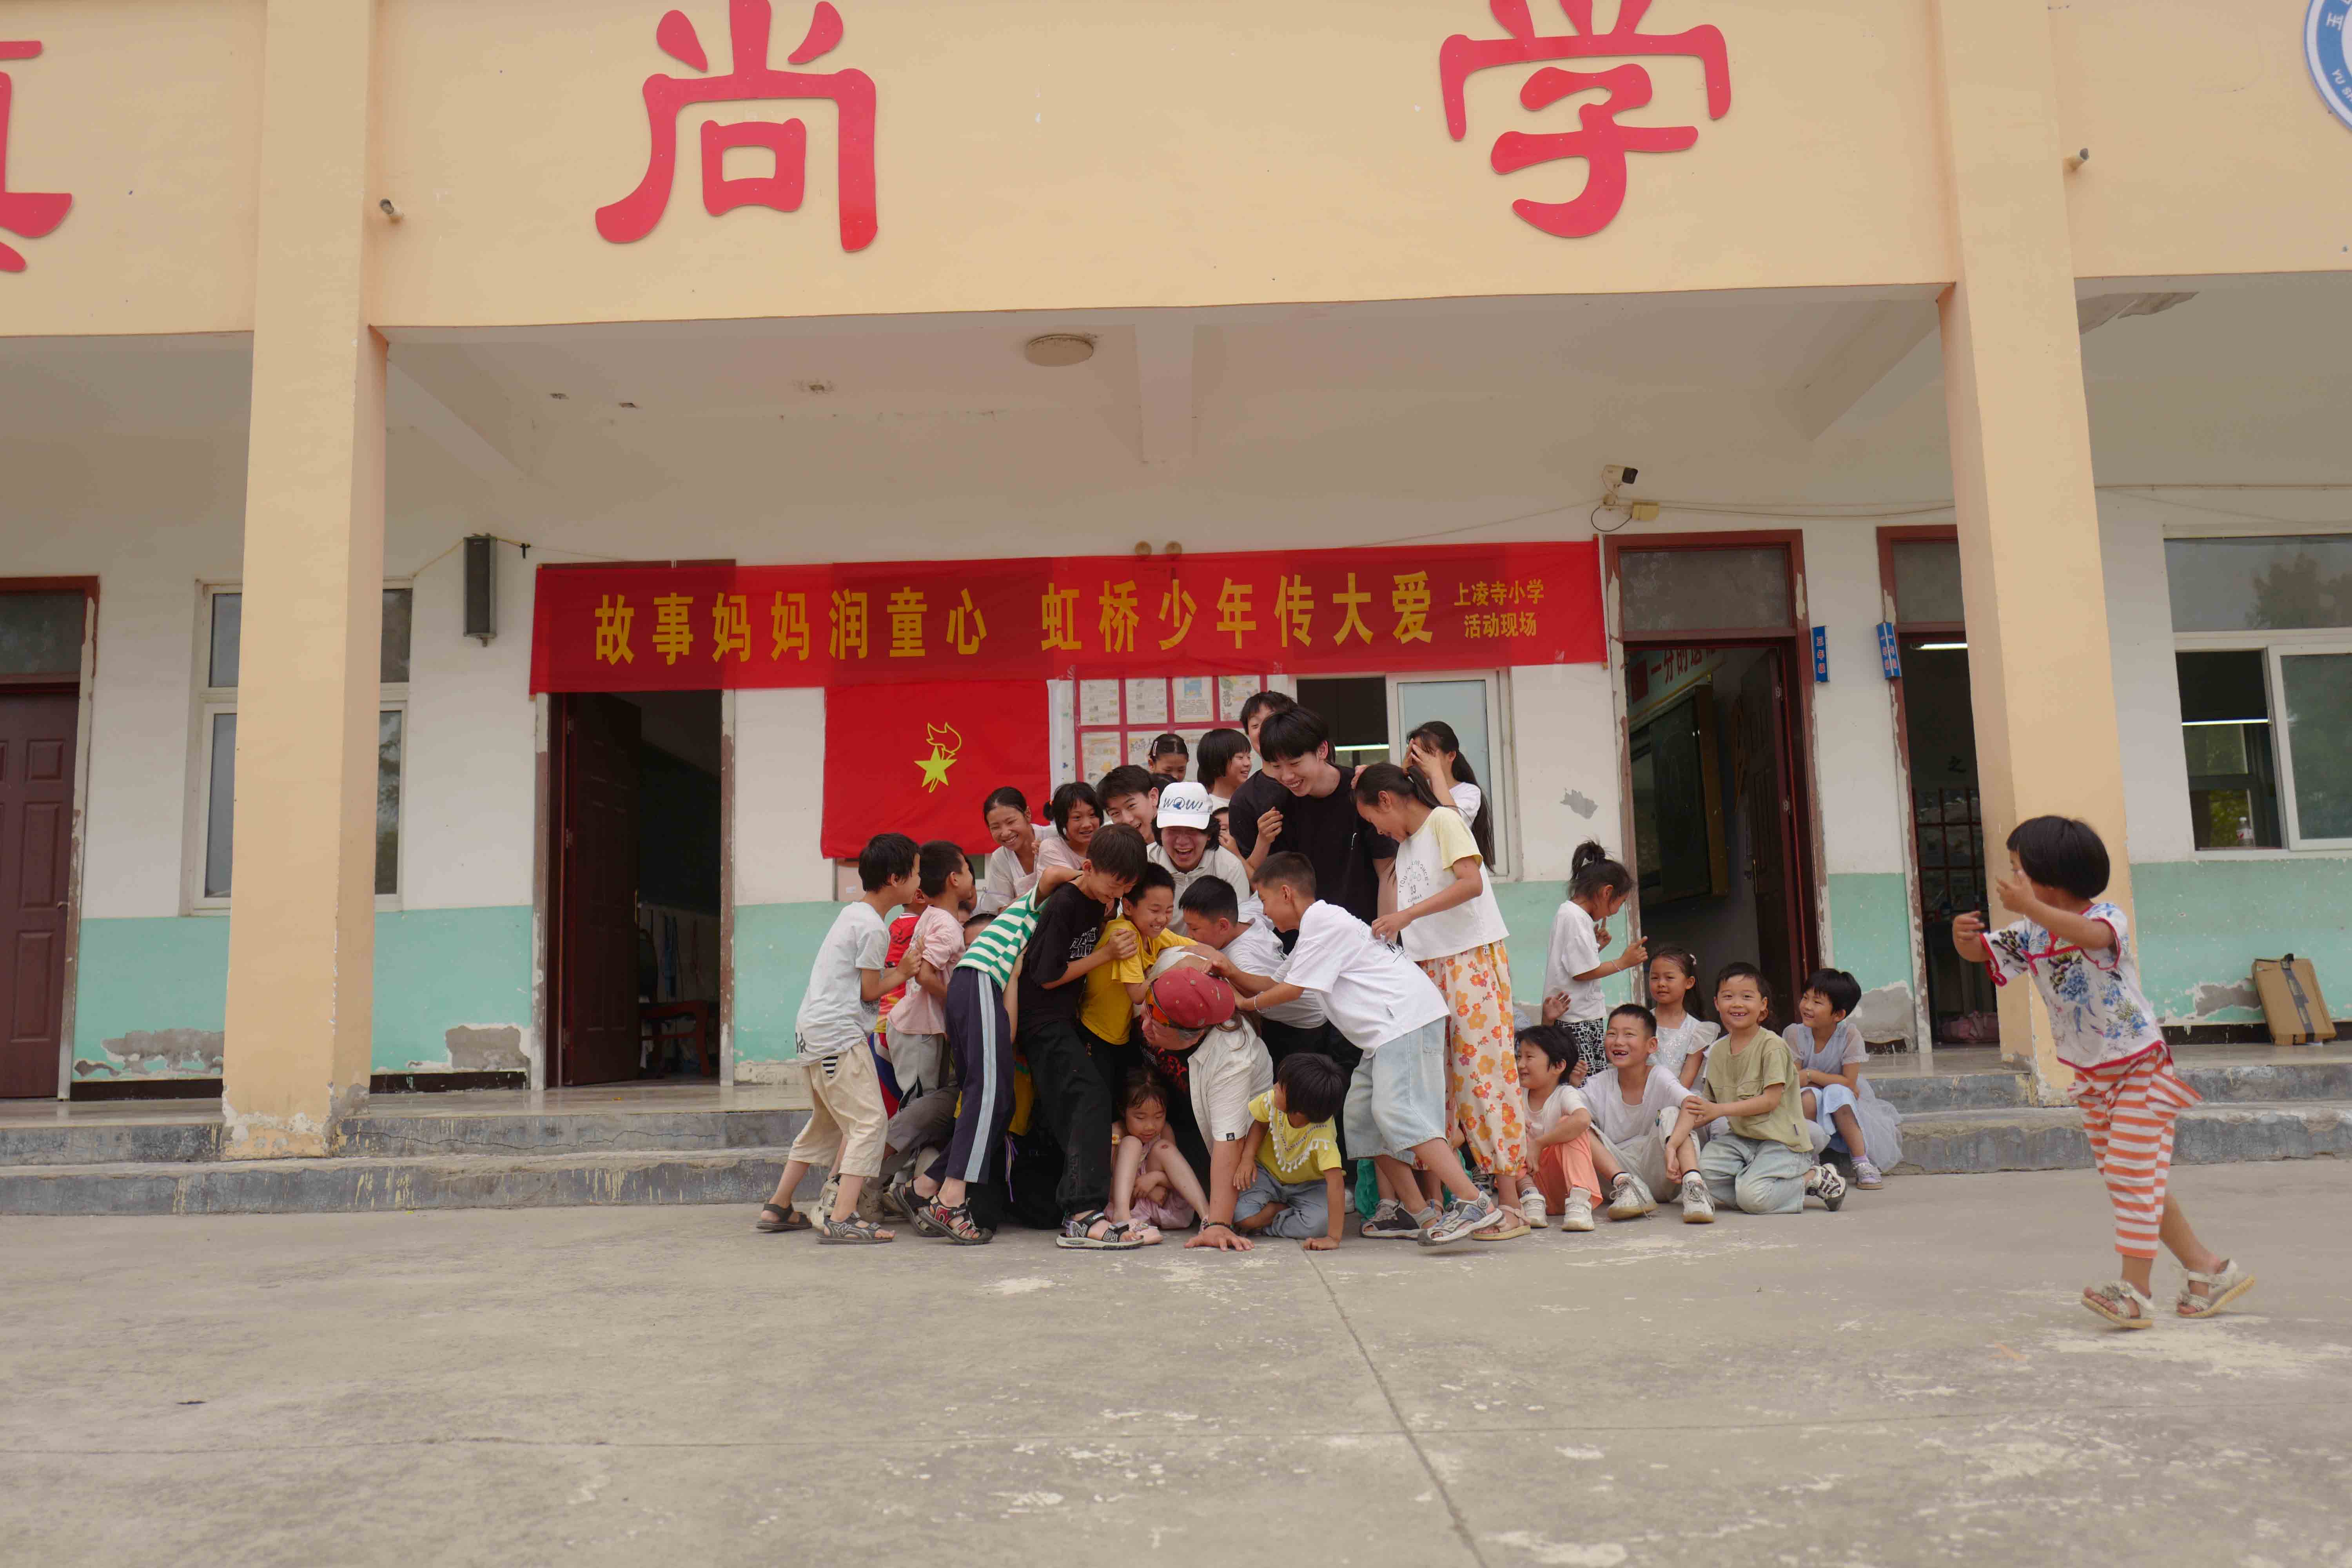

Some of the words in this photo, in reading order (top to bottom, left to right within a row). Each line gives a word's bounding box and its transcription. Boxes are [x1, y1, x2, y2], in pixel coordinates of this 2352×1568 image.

[595, 0, 878, 252] 尚
[1439, 0, 1731, 238] 学
[1454, 579, 1544, 606] 上凌寺小学
[595, 586, 987, 666] 故事妈妈润童心
[1041, 570, 1433, 653] 虹桥少年传大爱
[1464, 612, 1537, 639] 活动现场
[1163, 797, 1203, 811] WOW!
